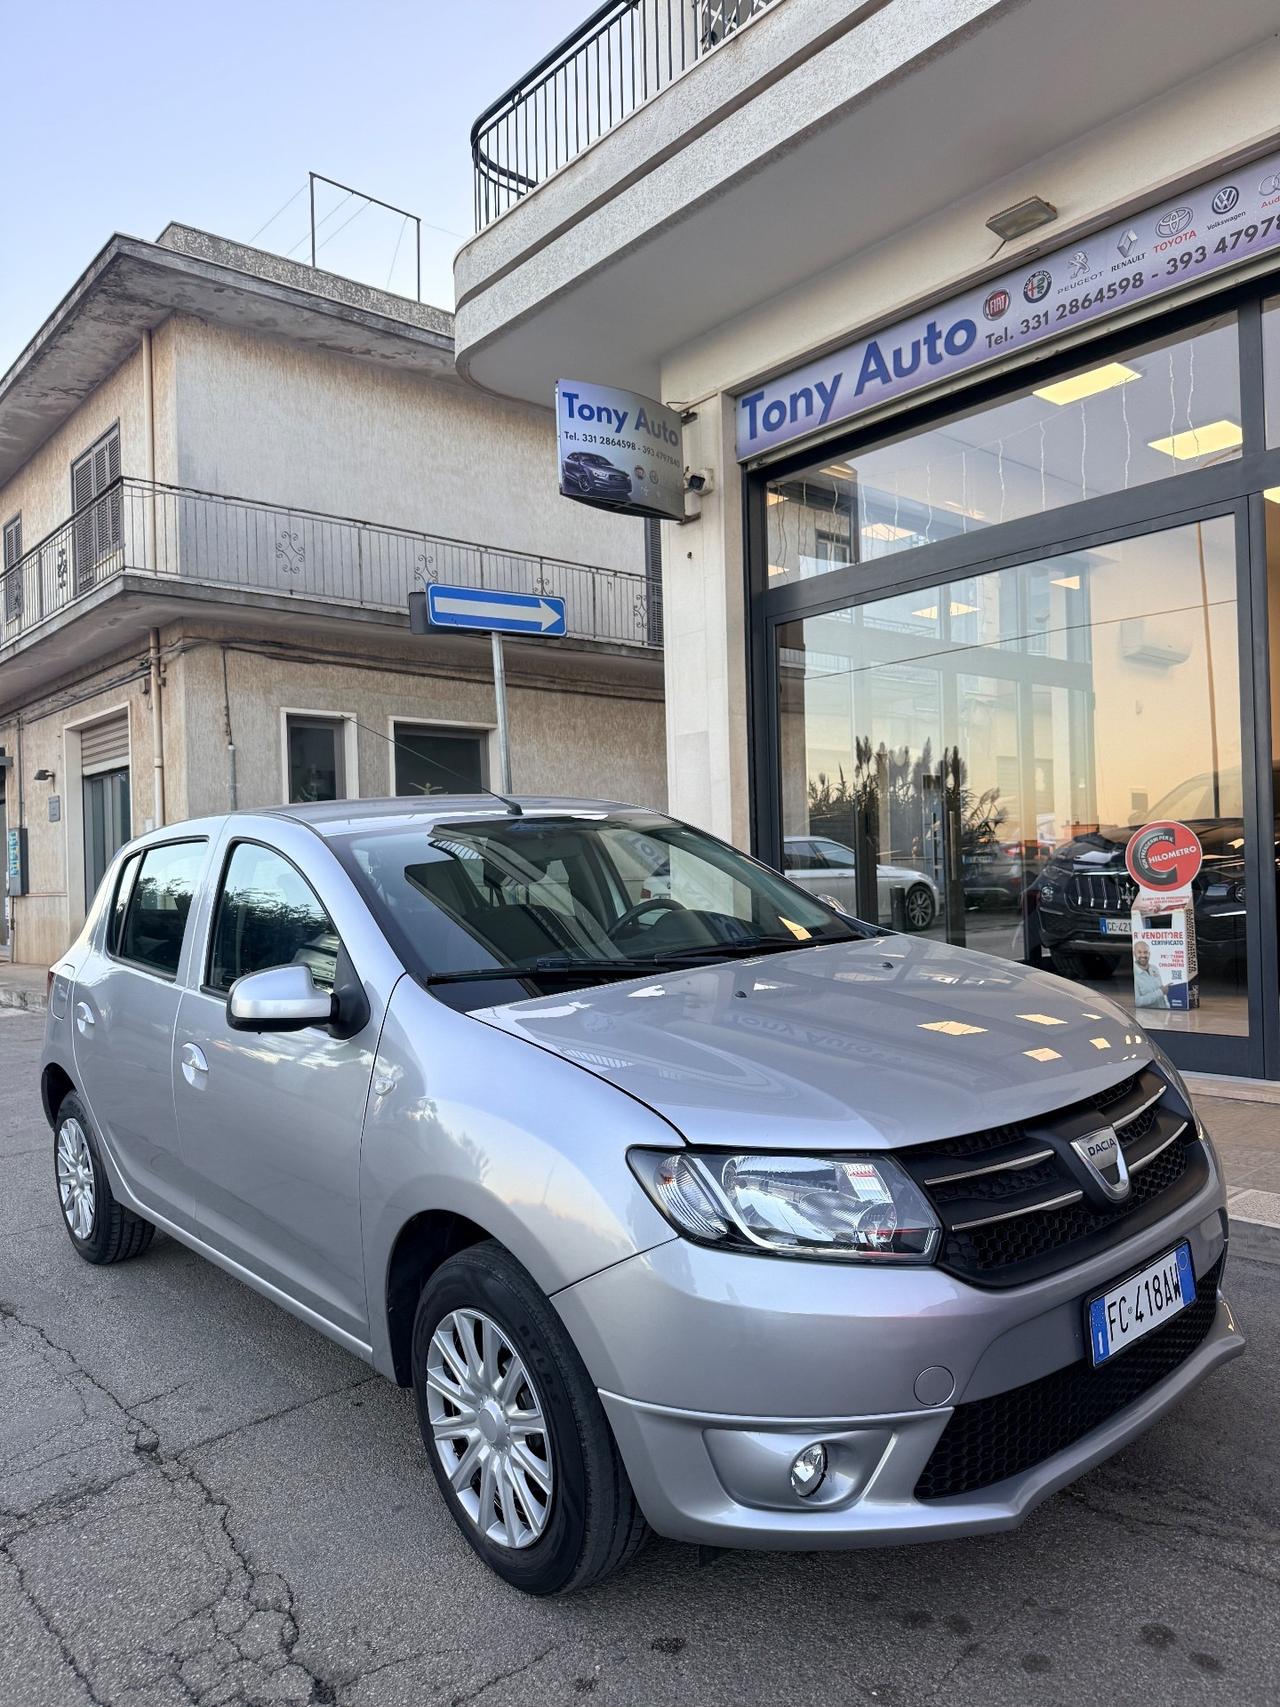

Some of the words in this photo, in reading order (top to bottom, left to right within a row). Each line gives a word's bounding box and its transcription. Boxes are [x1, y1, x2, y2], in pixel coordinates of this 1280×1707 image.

[1206, 211, 1246, 231] Volkswagen
[1153, 230, 1197, 253] TOYOTA
[1111, 253, 1146, 273] RENAULT
[1057, 271, 1105, 294] PEUGEOT
[986, 328, 1014, 348] Tel.
[1020, 310, 1050, 335] 331
[1055, 272, 1145, 321] 2864598
[1166, 246, 1207, 276] 393
[989, 294, 1006, 315] FIAT
[741, 373, 843, 440] Tony
[854, 318, 977, 397] Auto
[562, 392, 629, 433] Tony
[635, 407, 679, 447] Auto
[564, 431, 579, 441] Tel.
[582, 433, 597, 443] 331
[599, 436, 636, 451] 2864598
[642, 445, 655, 457] 393
[1087, 1137, 1118, 1157] DACIA
